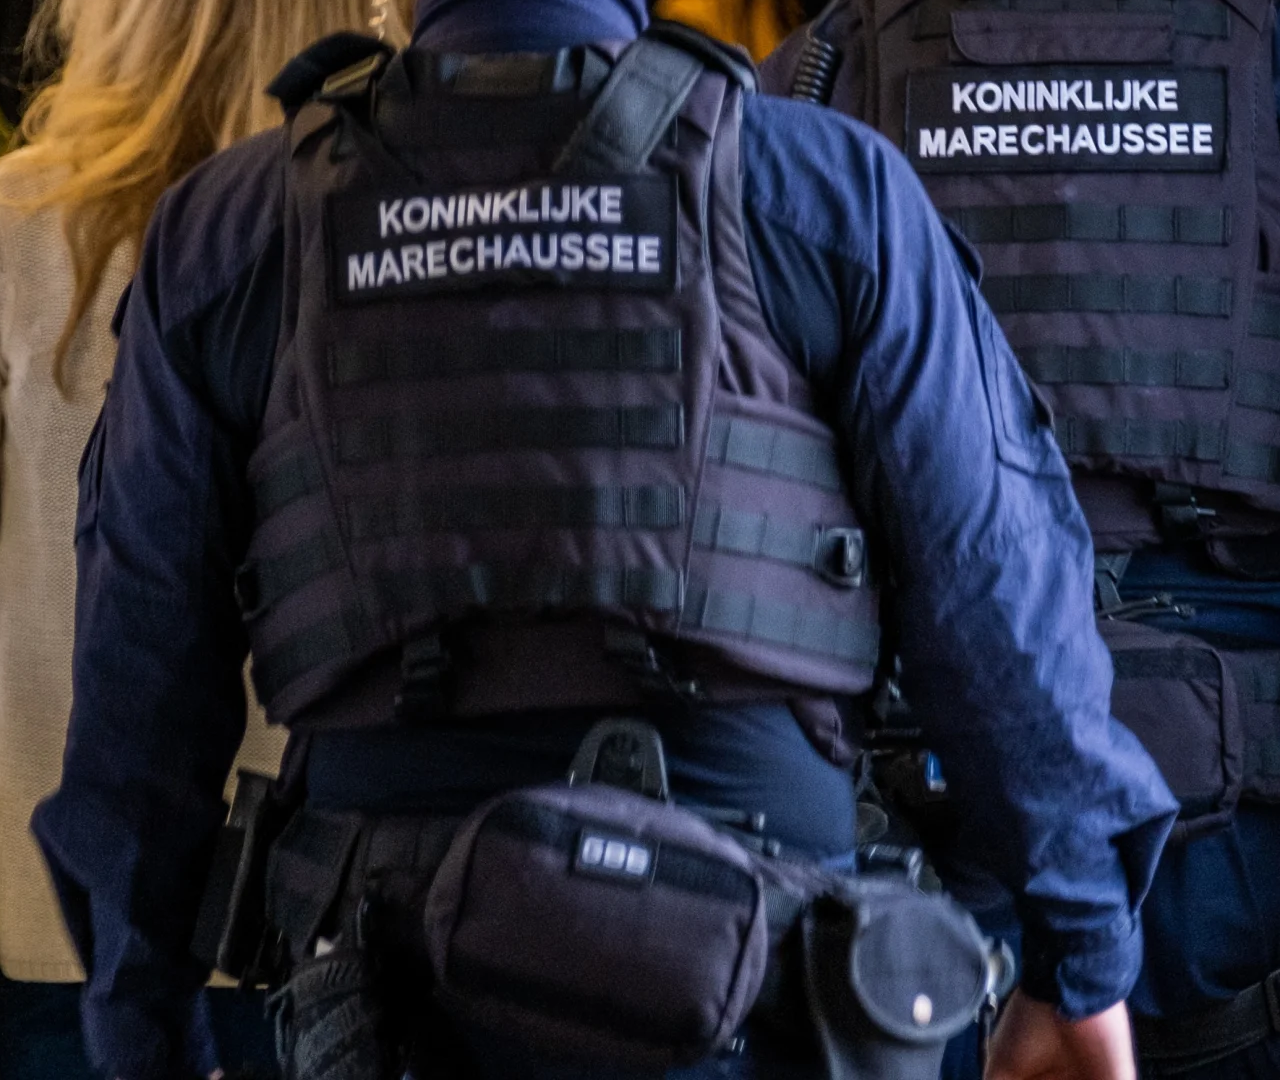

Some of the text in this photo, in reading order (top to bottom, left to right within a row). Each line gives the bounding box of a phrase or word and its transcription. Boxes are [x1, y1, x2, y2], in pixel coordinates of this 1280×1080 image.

[951, 78, 1179, 115] KONINKLIJKE
[918, 122, 1214, 158] MARECHAUSSEE
[378, 185, 623, 239] KONINKLIJKE
[346, 232, 661, 291] MARECHAUSSEE
